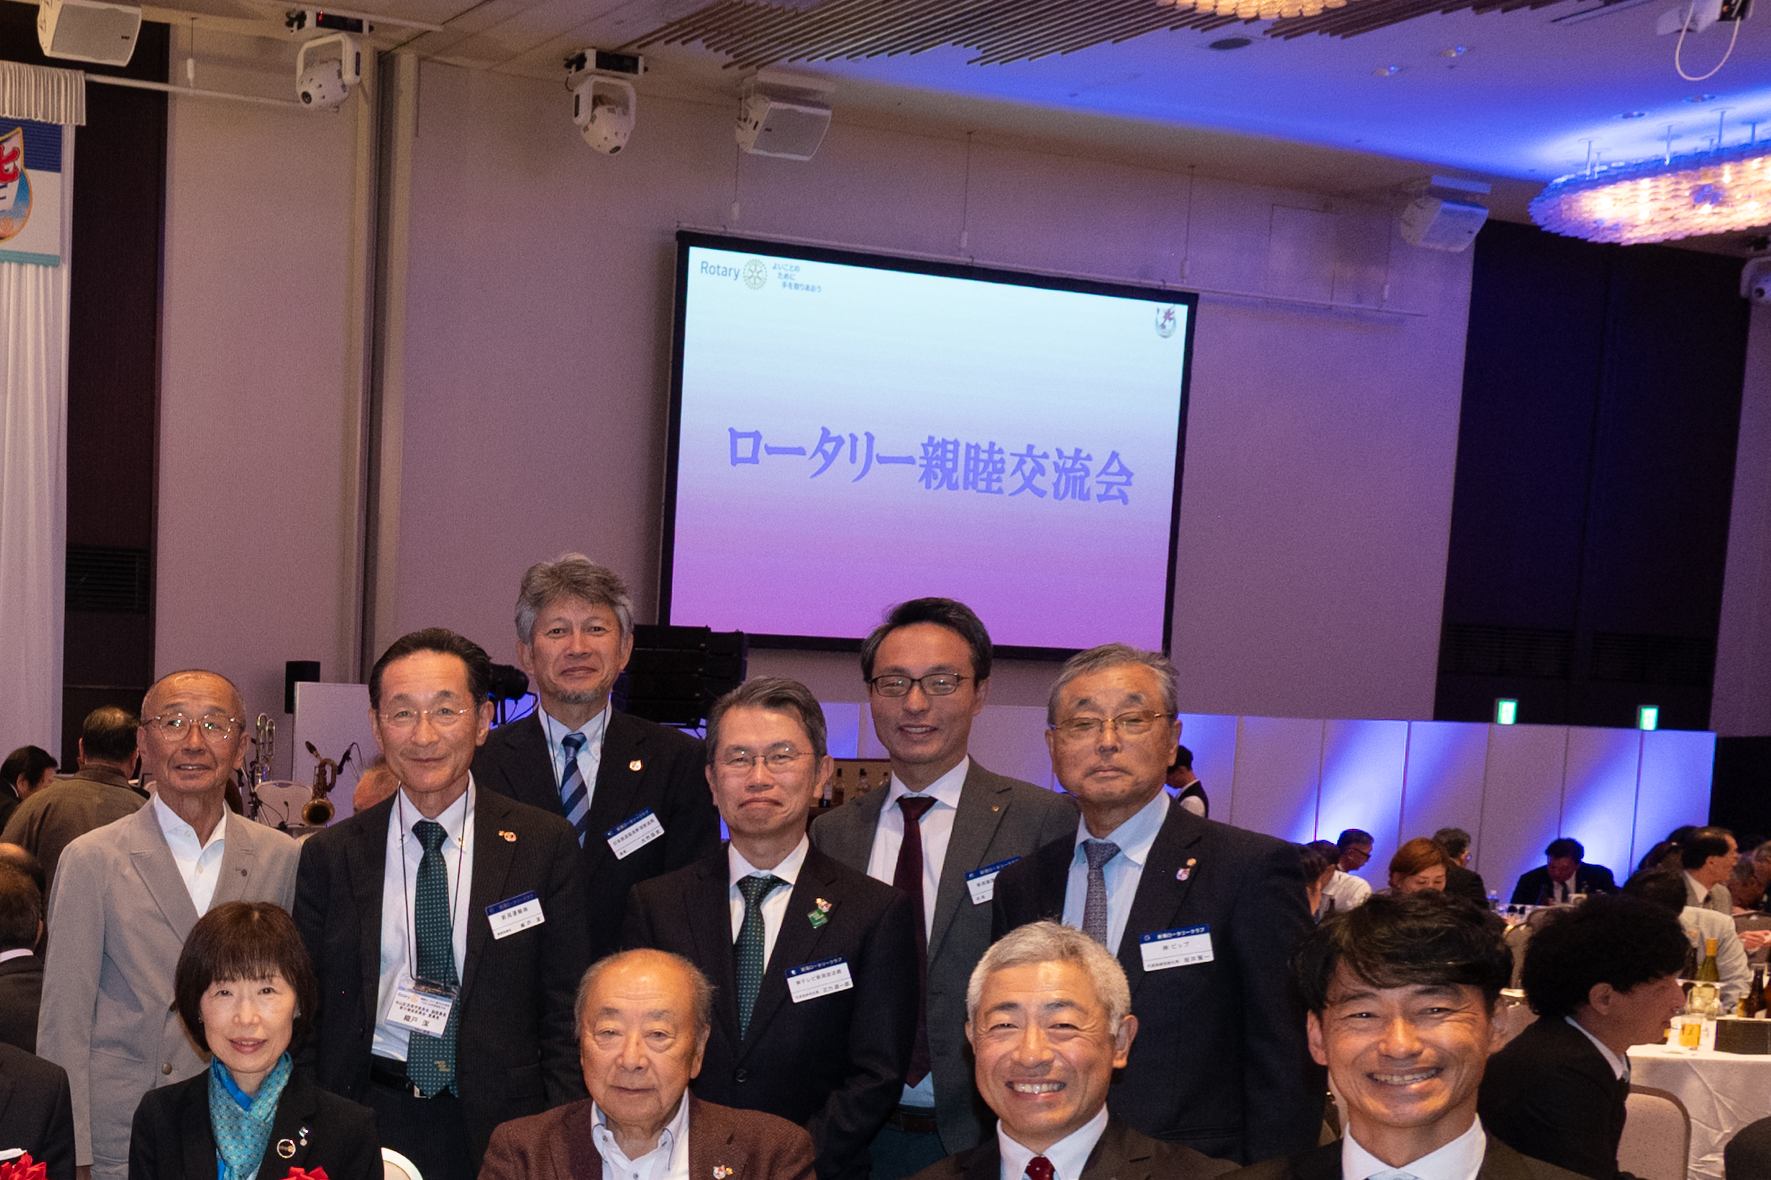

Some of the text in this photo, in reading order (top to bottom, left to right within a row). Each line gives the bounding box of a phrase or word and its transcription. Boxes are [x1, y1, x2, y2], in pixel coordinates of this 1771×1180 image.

[700, 260, 741, 281] Rotary
[727, 426, 1135, 506] ロータリー親睦交流会
